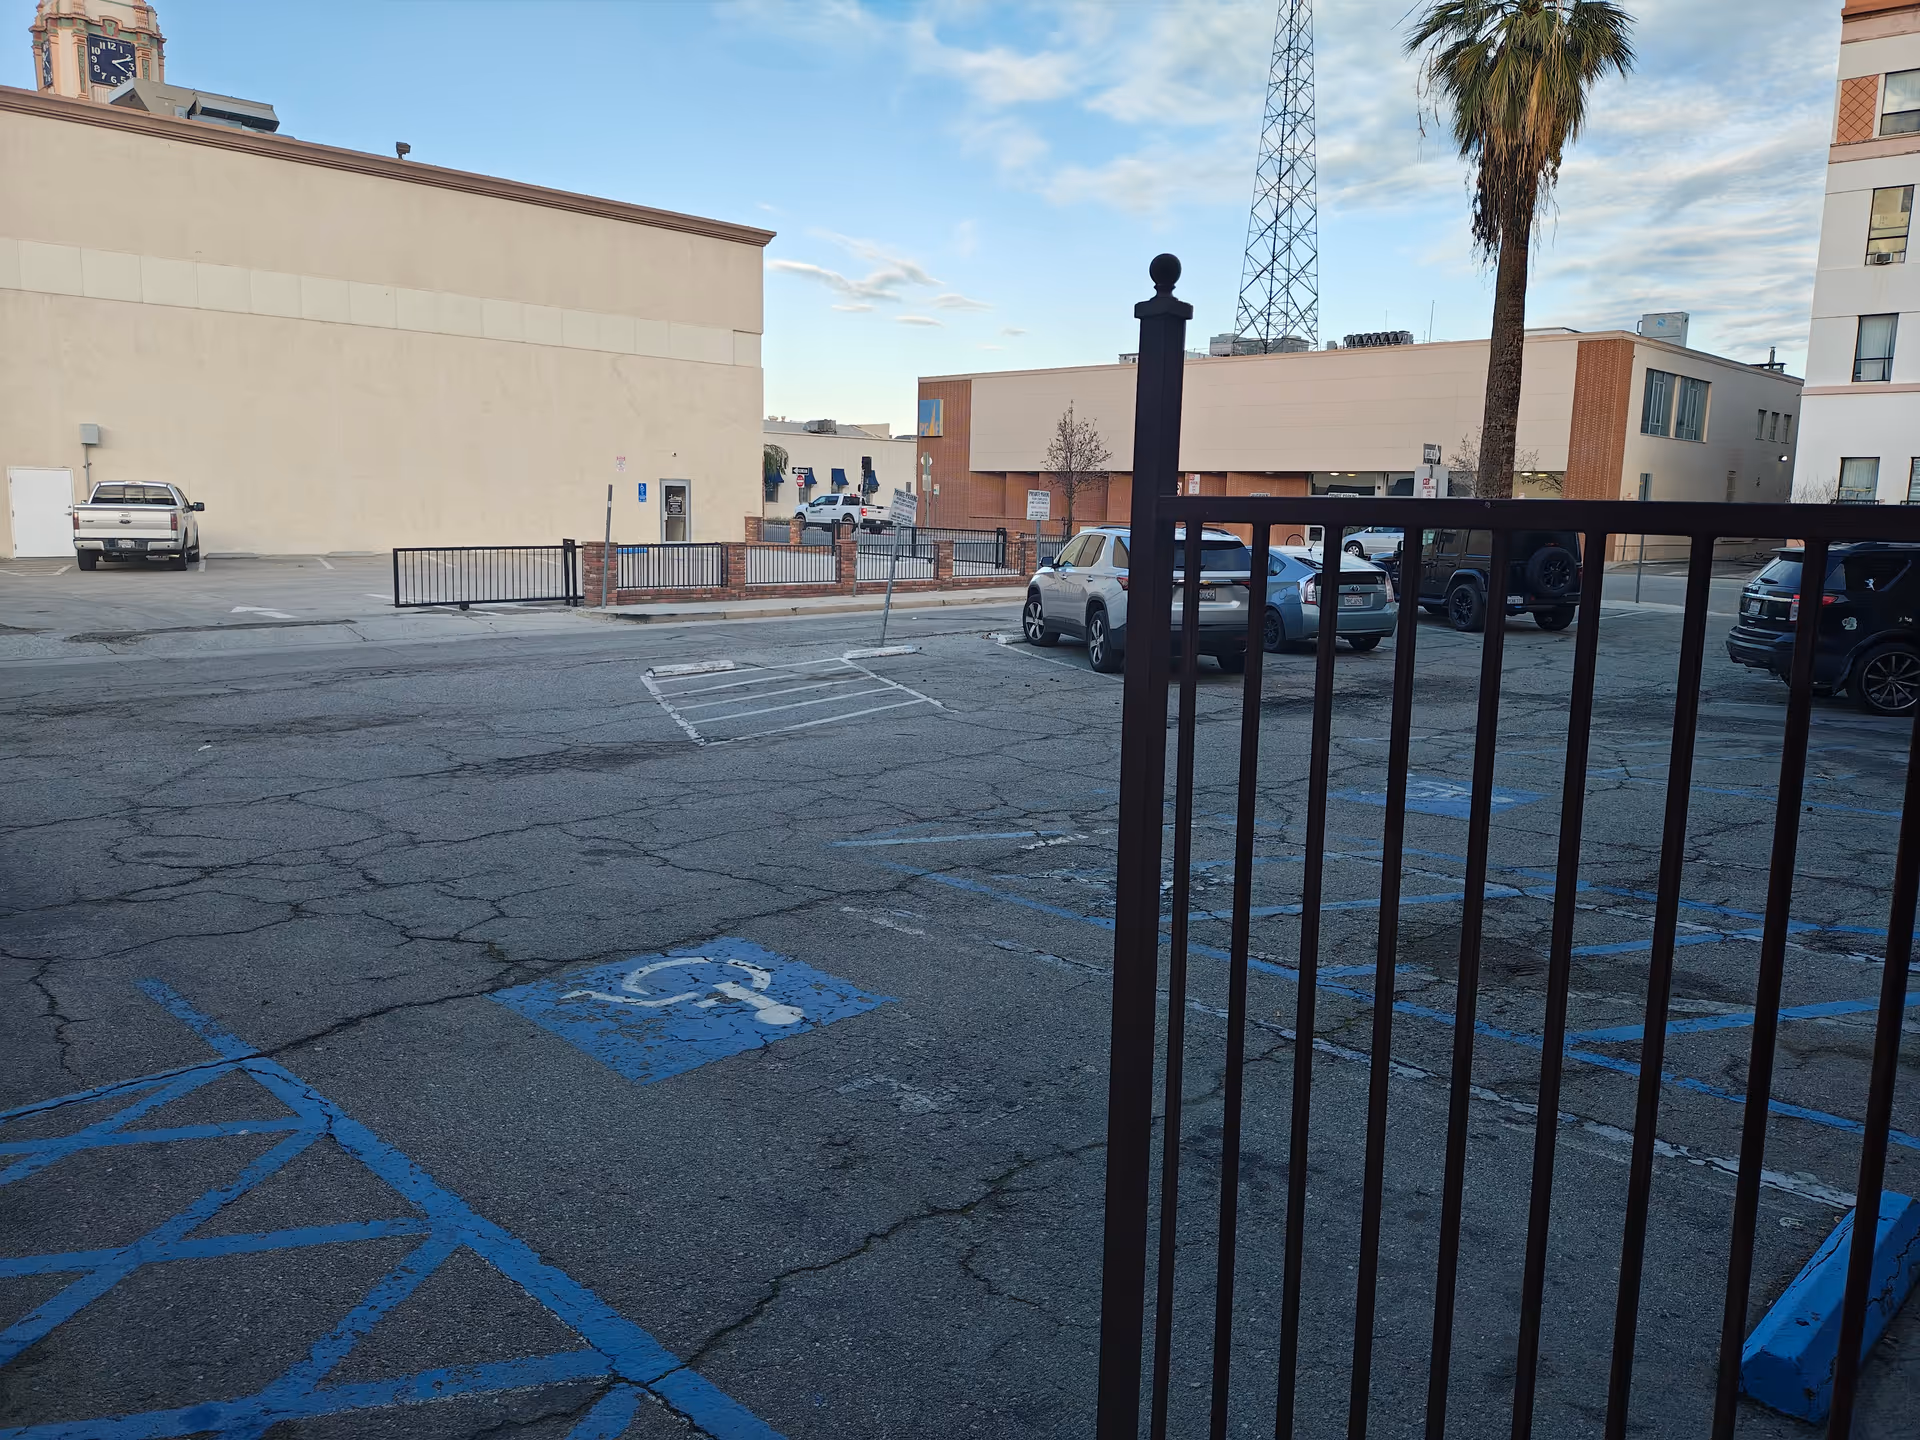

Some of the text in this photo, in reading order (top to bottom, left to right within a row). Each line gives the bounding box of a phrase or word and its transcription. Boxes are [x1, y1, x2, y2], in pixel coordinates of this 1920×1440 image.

[100, 41, 106, 50] 11
[108, 41, 117, 50] 12
[91, 46, 100, 55] 10
[94, 64, 100, 72] 8
[128, 62, 134, 70] 3
[110, 76, 117, 84] 6
